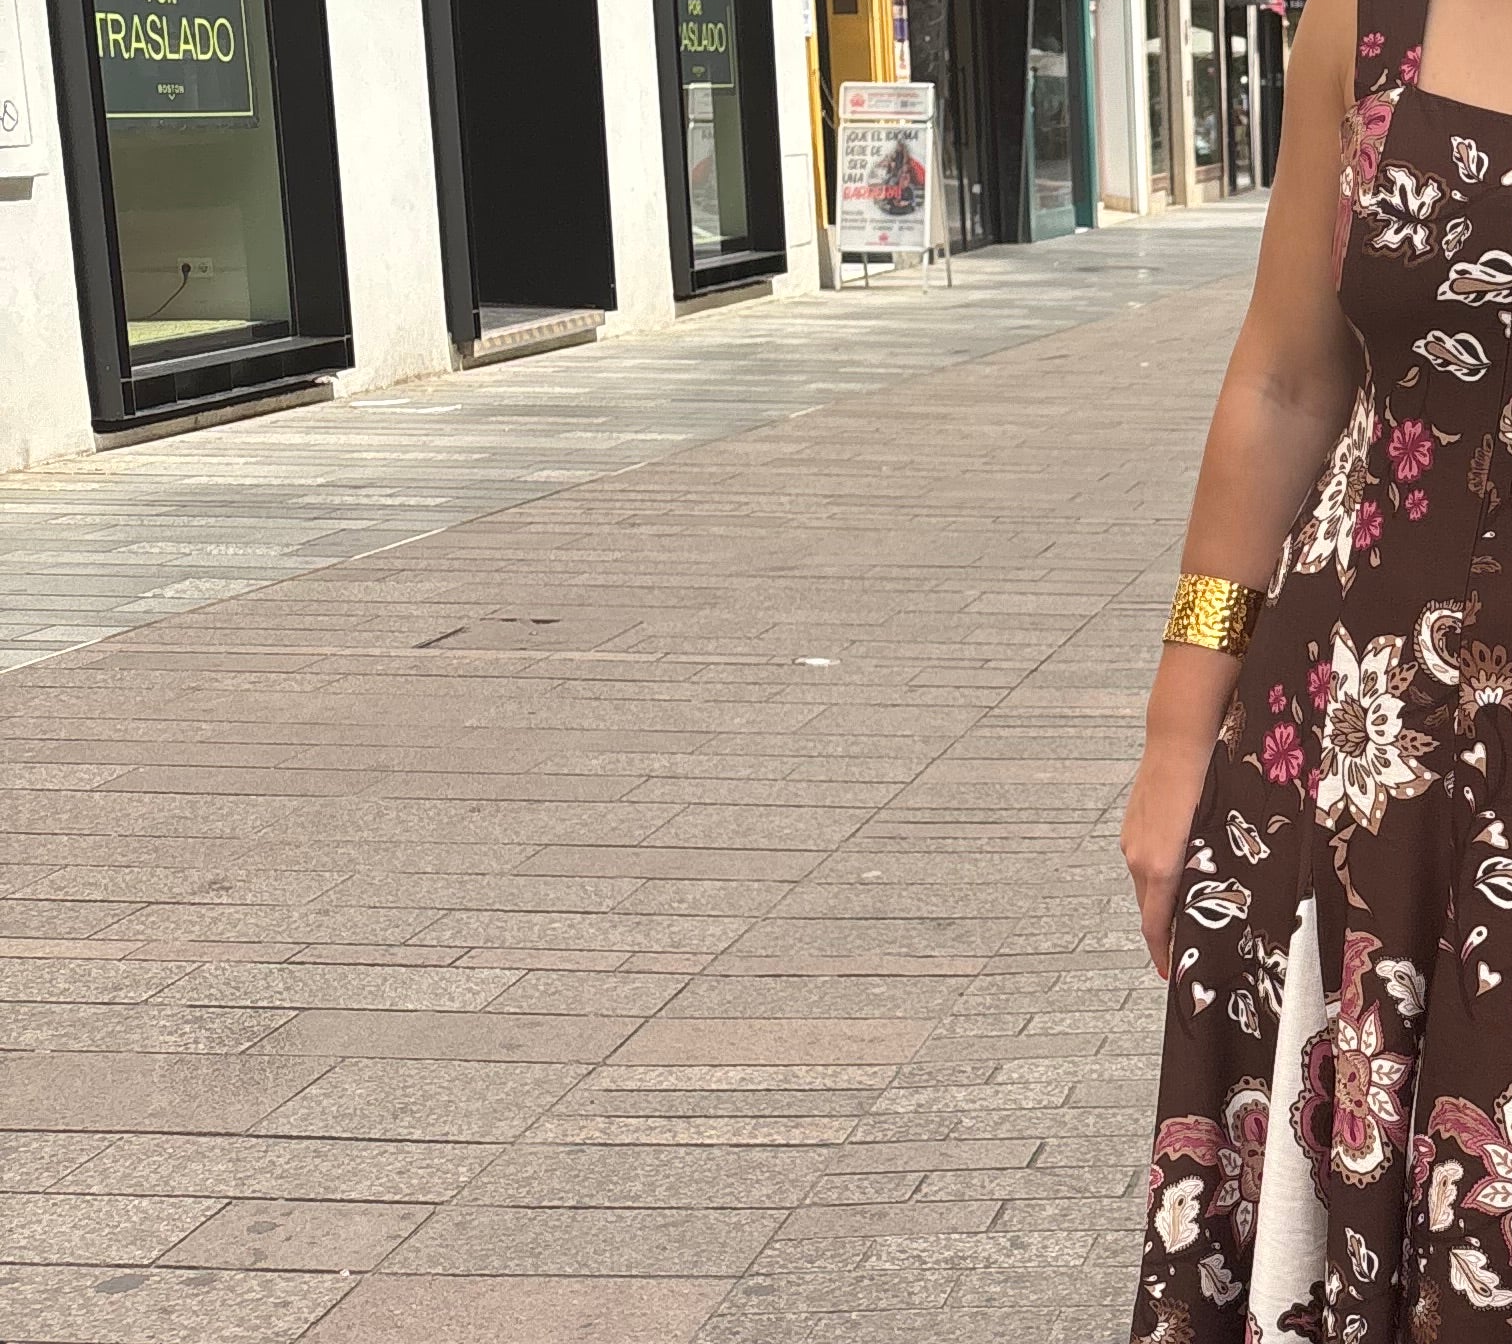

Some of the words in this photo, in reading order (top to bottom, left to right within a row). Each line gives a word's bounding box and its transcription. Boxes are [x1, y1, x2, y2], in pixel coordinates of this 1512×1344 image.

[687, 0, 703, 15] POR
[95, 12, 235, 62] TRASLADO
[679, 21, 727, 53] ASLADO
